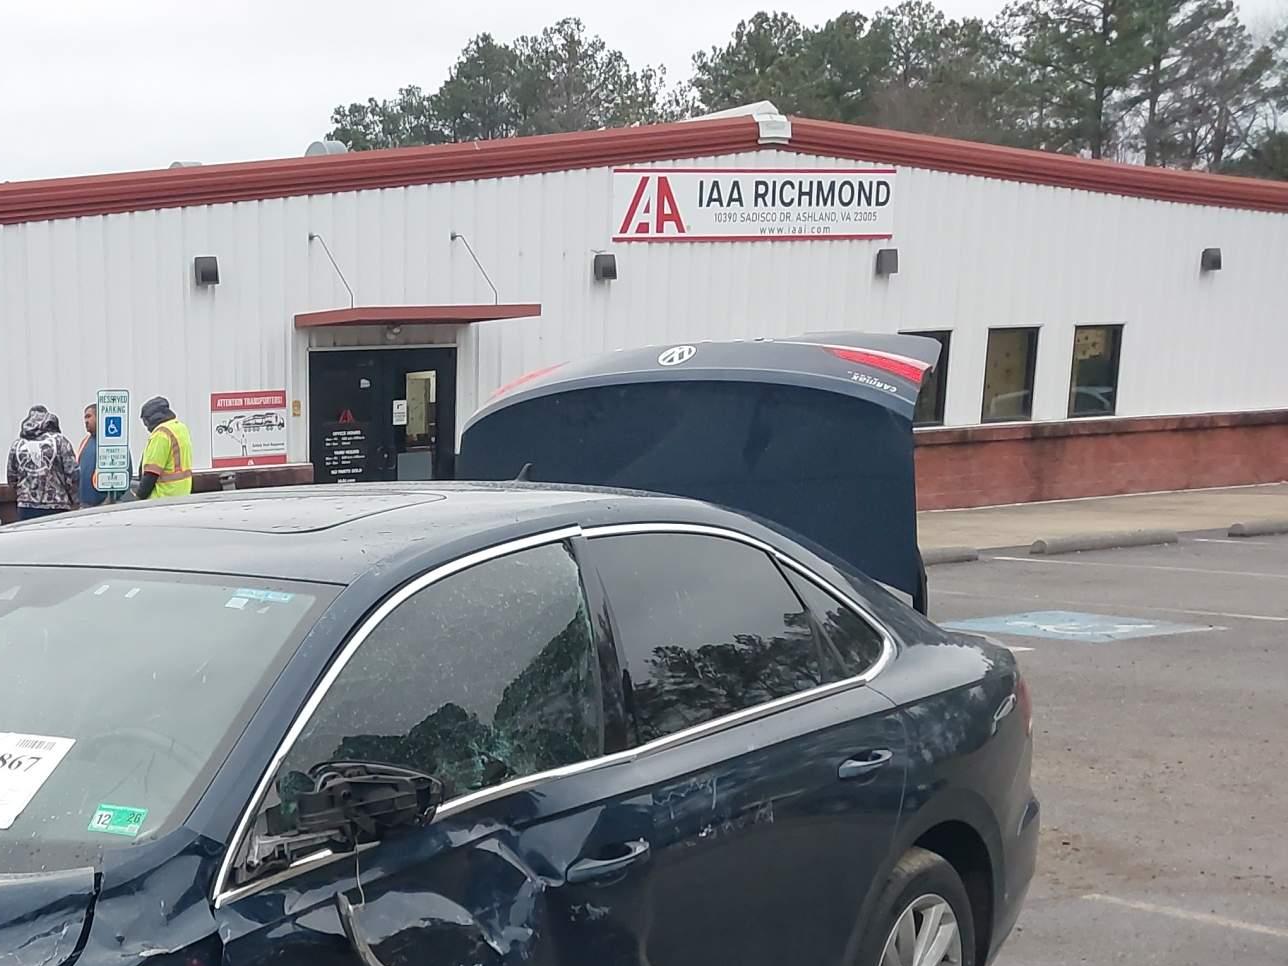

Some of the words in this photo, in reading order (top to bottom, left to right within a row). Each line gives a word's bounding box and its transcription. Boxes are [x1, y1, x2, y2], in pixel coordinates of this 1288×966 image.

[698, 180, 744, 208] IAA
[753, 180, 891, 208] RICHMOND
[714, 212, 737, 223] 10390
[740, 212, 777, 222] SADISCO
[840, 212, 851, 222] VA
[854, 211, 877, 222] 23005
[101, 405, 126, 414] PARKING
[96, 814, 112, 826] 12
